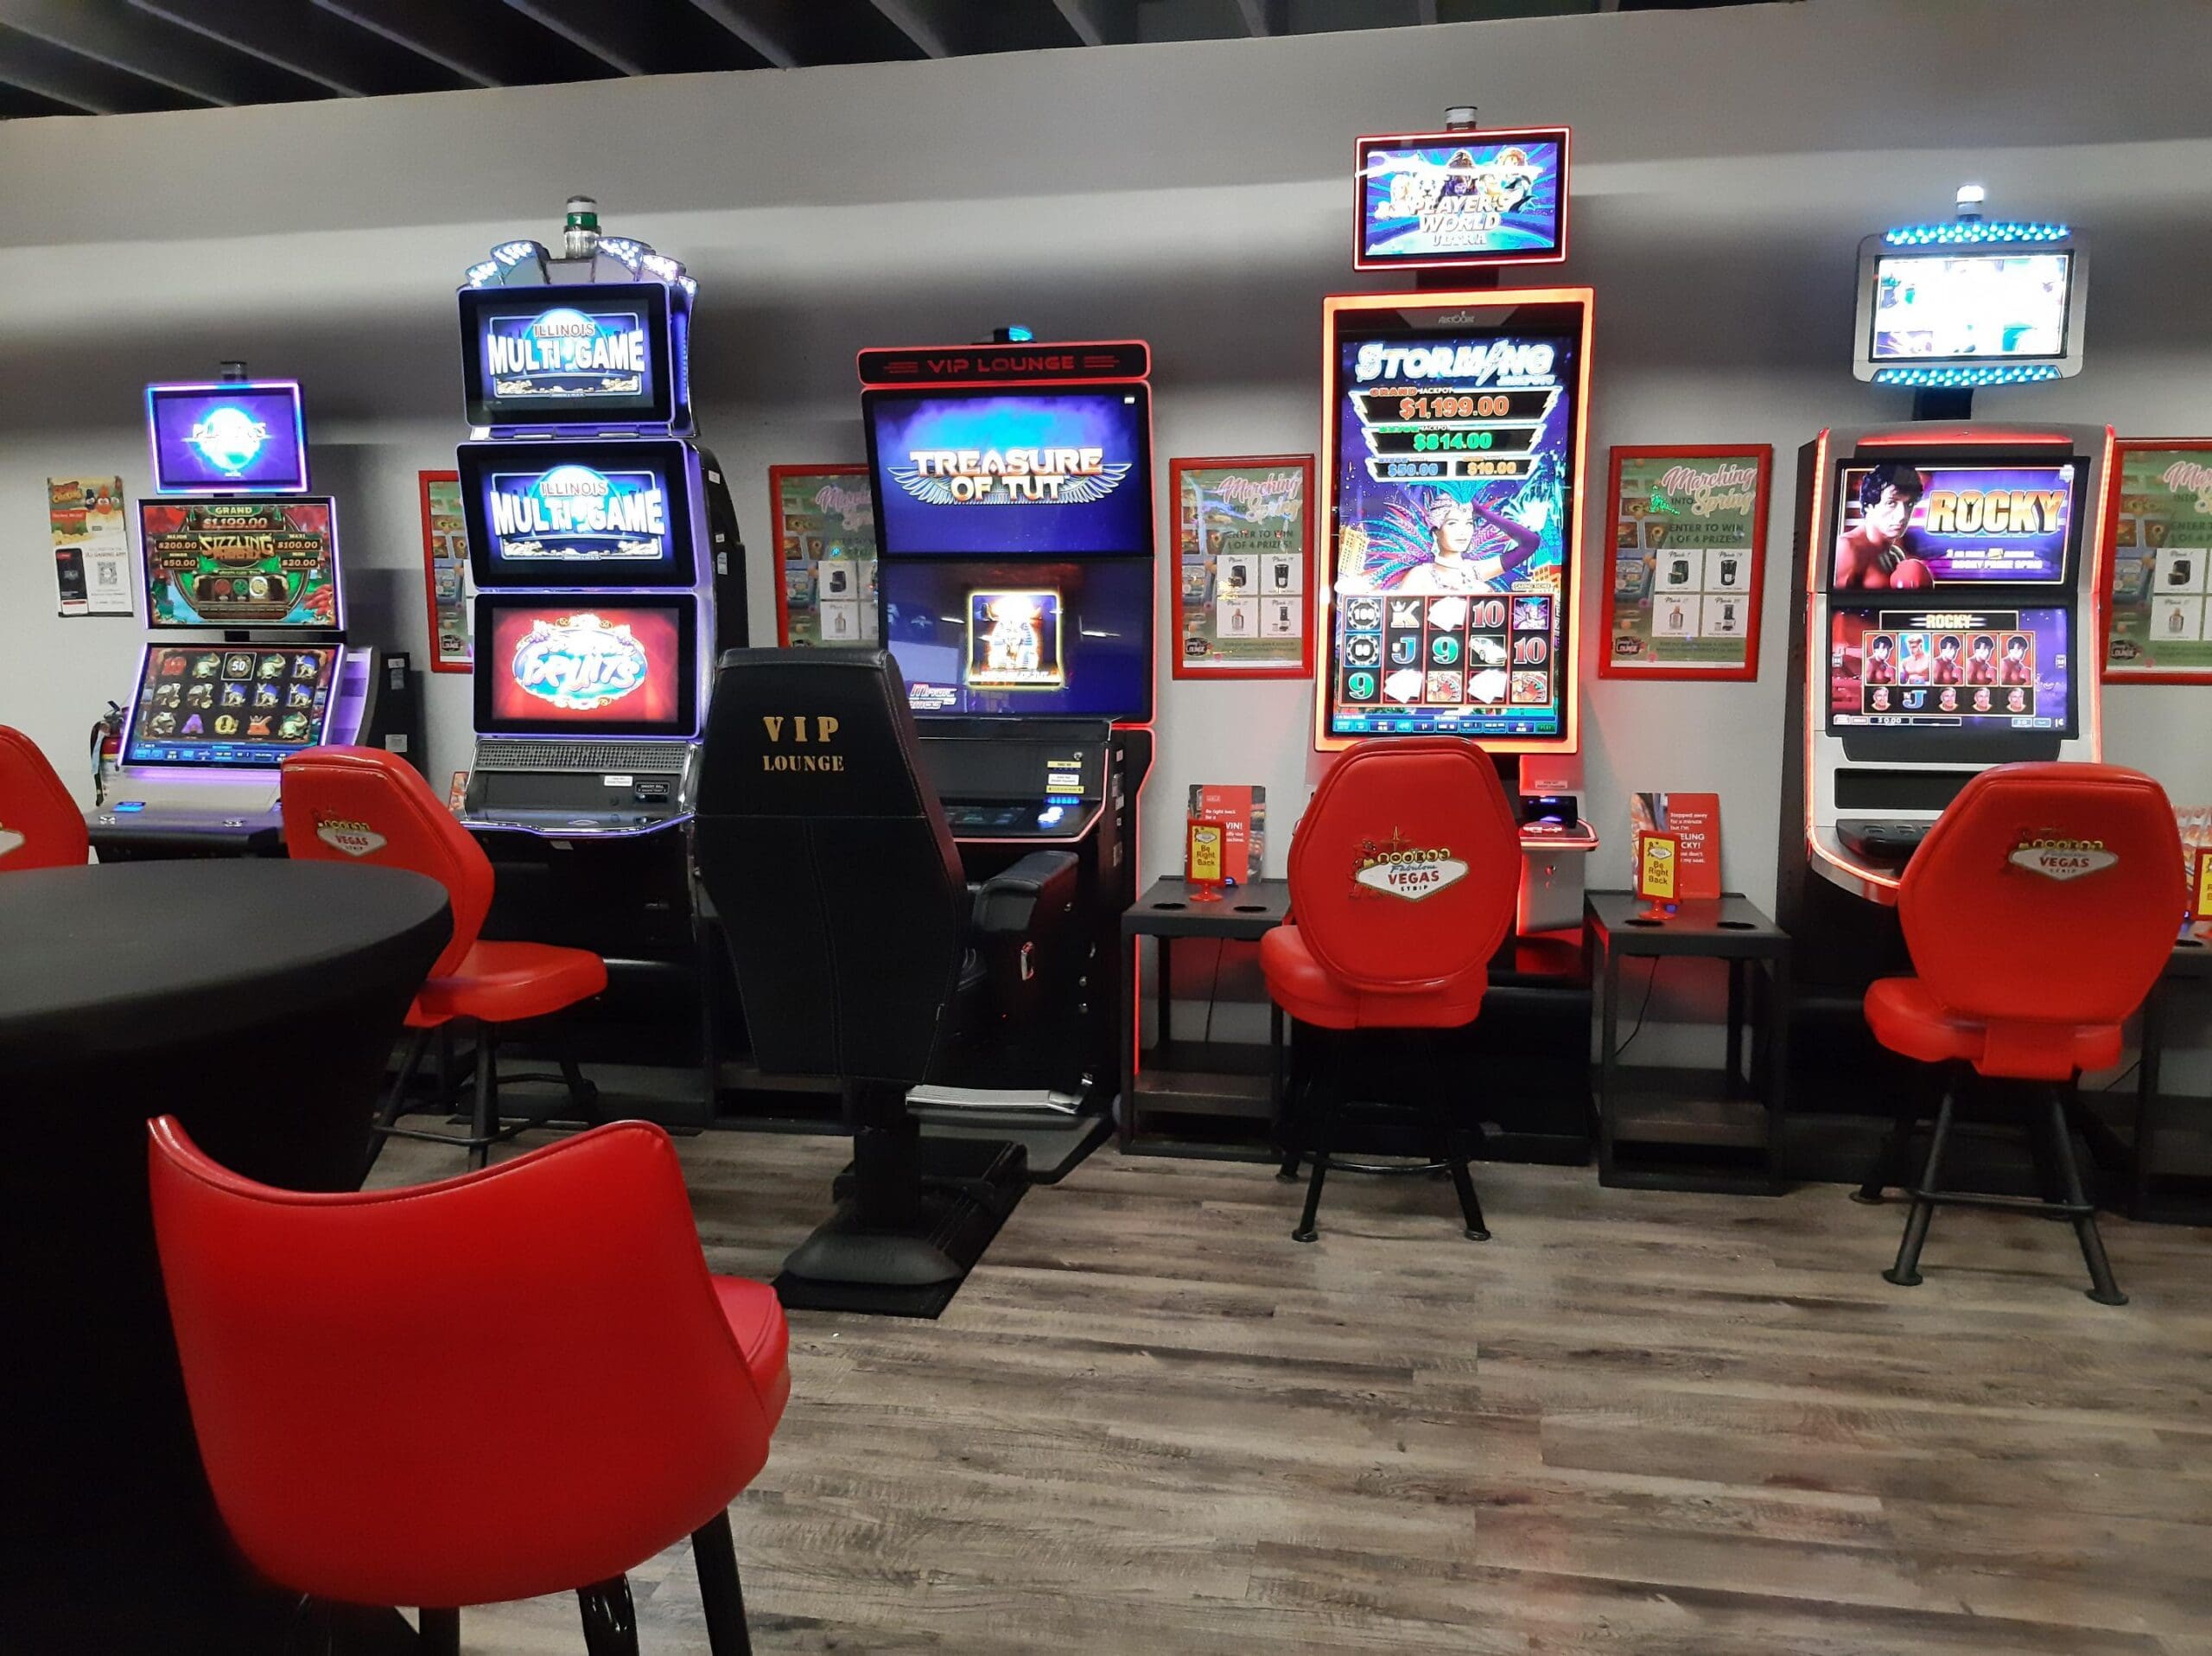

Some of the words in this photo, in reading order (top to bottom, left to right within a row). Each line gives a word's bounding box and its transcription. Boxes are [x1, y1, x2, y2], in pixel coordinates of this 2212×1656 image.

[1419, 212, 1501, 232] WORLD
[533, 323, 594, 337] ILLINOIS
[487, 334, 561, 375] MULTI
[575, 330, 645, 372] GAME
[926, 359, 969, 373] VIP
[978, 355, 1074, 373] LOUNGE
[1356, 341, 1554, 385] STORMING
[1370, 387, 1417, 397] GRAND
[1400, 396, 1509, 420] $1,199.00
[1414, 433, 1492, 452] $814.00
[909, 448, 1103, 476] TREASURE
[1388, 463, 1439, 476] $50.00
[1467, 462, 1517, 475] $10.00
[540, 481, 608, 497] ILLINOIS
[950, 476, 993, 501] OF
[1002, 476, 1064, 501] TUT
[1217, 472, 1302, 504] Marching
[1662, 463, 1758, 496] Marching
[1671, 497, 1694, 506] INTO
[1691, 485, 1756, 518] Spring
[1925, 489, 2066, 534] ROCKY
[490, 491, 572, 536] MULTI
[585, 488, 664, 534] GAME
[202, 518, 268, 529] $1,199.00
[1669, 524, 1702, 532] ENTER
[1722, 523, 1745, 532] WIN
[199, 532, 275, 558] SIZZLING
[1390, 601, 1420, 627] K
[1472, 601, 1505, 627] 10
[1925, 614, 1972, 629] ROCKY
[1391, 637, 1417, 664] J
[1432, 637, 1459, 664] 9
[1514, 637, 1546, 664] 10
[232, 660, 245, 672] 50
[1348, 672, 1374, 699] 9
[181, 714, 204, 734] A
[214, 714, 239, 735] Q
[763, 717, 839, 742] VIP
[762, 755, 844, 771] LOUNGE
[335, 835, 368, 845] VEGAS
[1389, 863, 1437, 873] Fabulous
[1649, 867, 1669, 876] Right
[2039, 857, 2089, 868] VEGAS
[1388, 870, 1440, 886] VEGAS
[1649, 876, 1668, 884] Back
